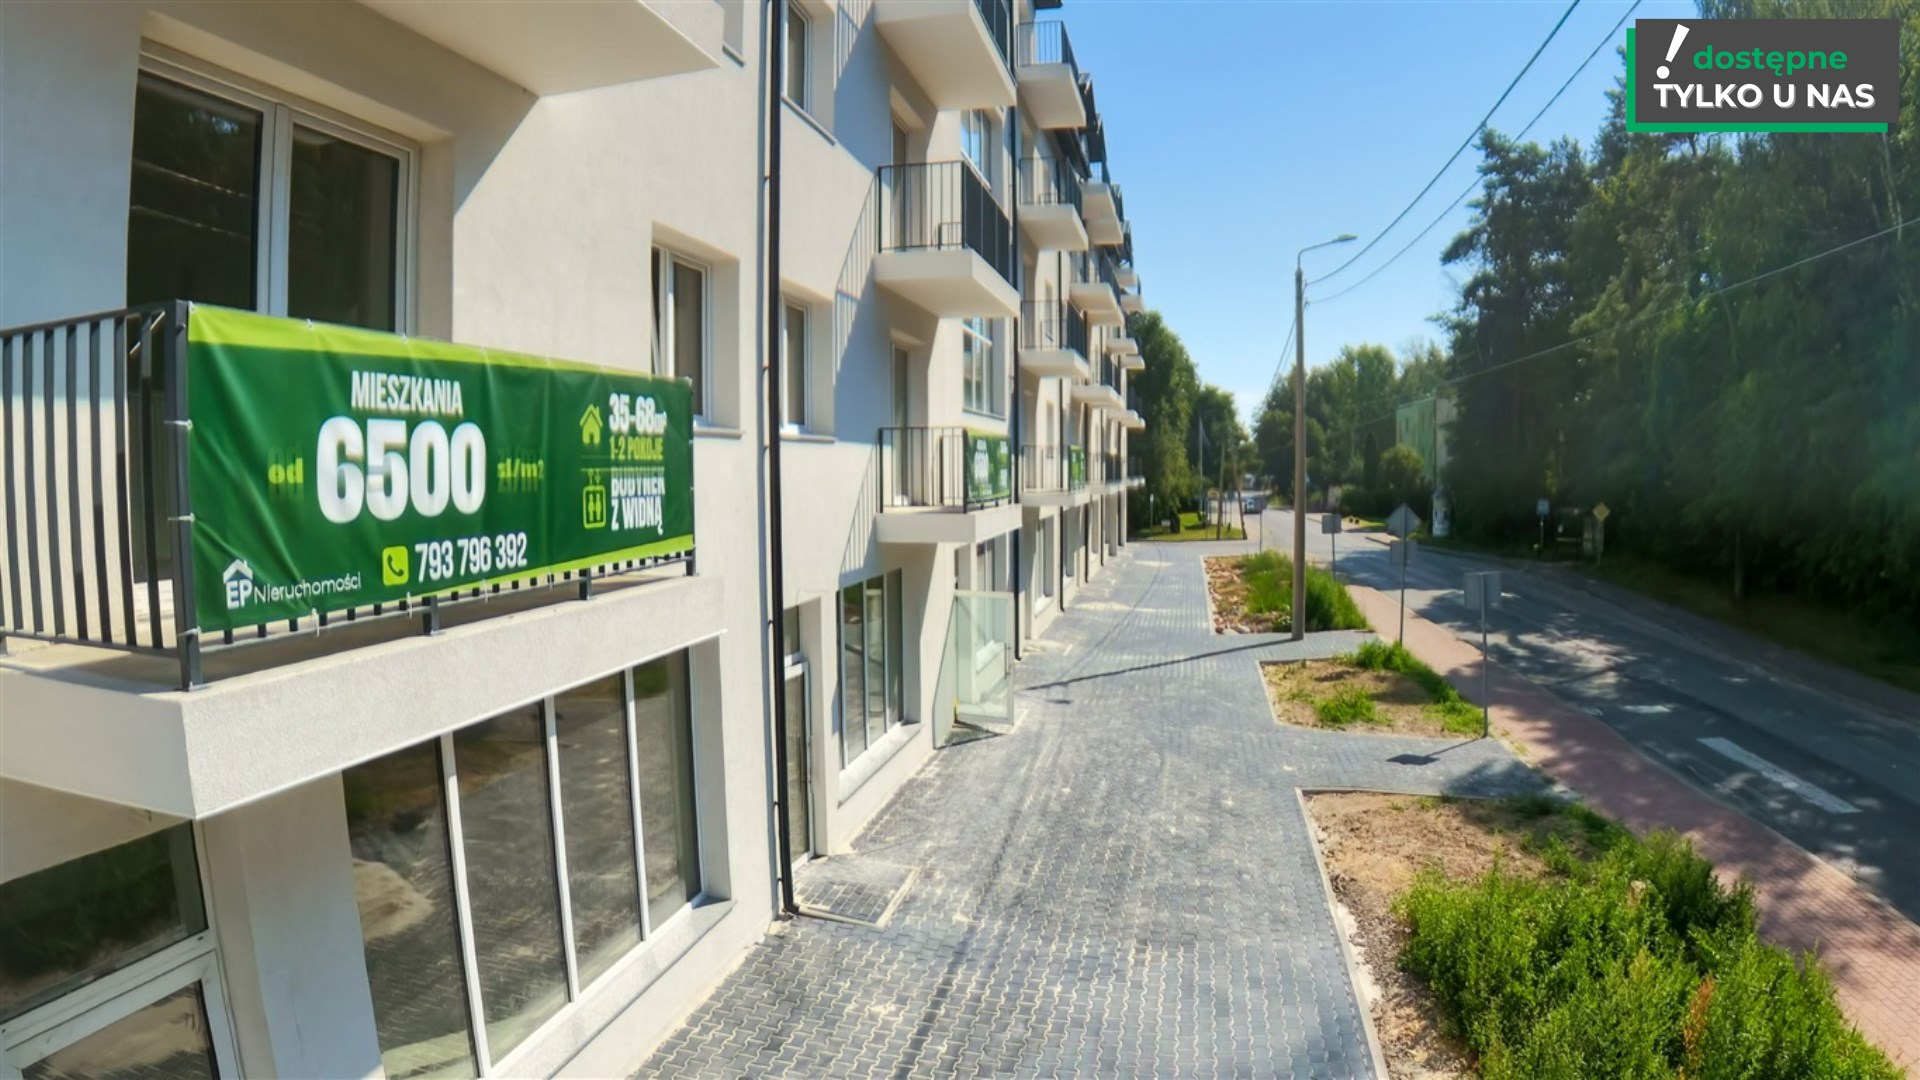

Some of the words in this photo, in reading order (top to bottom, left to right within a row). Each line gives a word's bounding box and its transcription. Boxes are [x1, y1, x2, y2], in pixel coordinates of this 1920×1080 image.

[351, 370, 463, 417] MIESZKANIA
[267, 453, 304, 487] od
[316, 415, 487, 523] 6500
[609, 434, 626, 460] 1-2
[627, 436, 664, 461] POKOJE
[611, 498, 620, 531] Z
[622, 495, 664, 535] WIDNĄ
[415, 542, 454, 583] 793
[457, 536, 491, 577] 796
[495, 532, 527, 569] 392
[225, 579, 252, 610] EP
[253, 572, 362, 605] Nieruchomości
